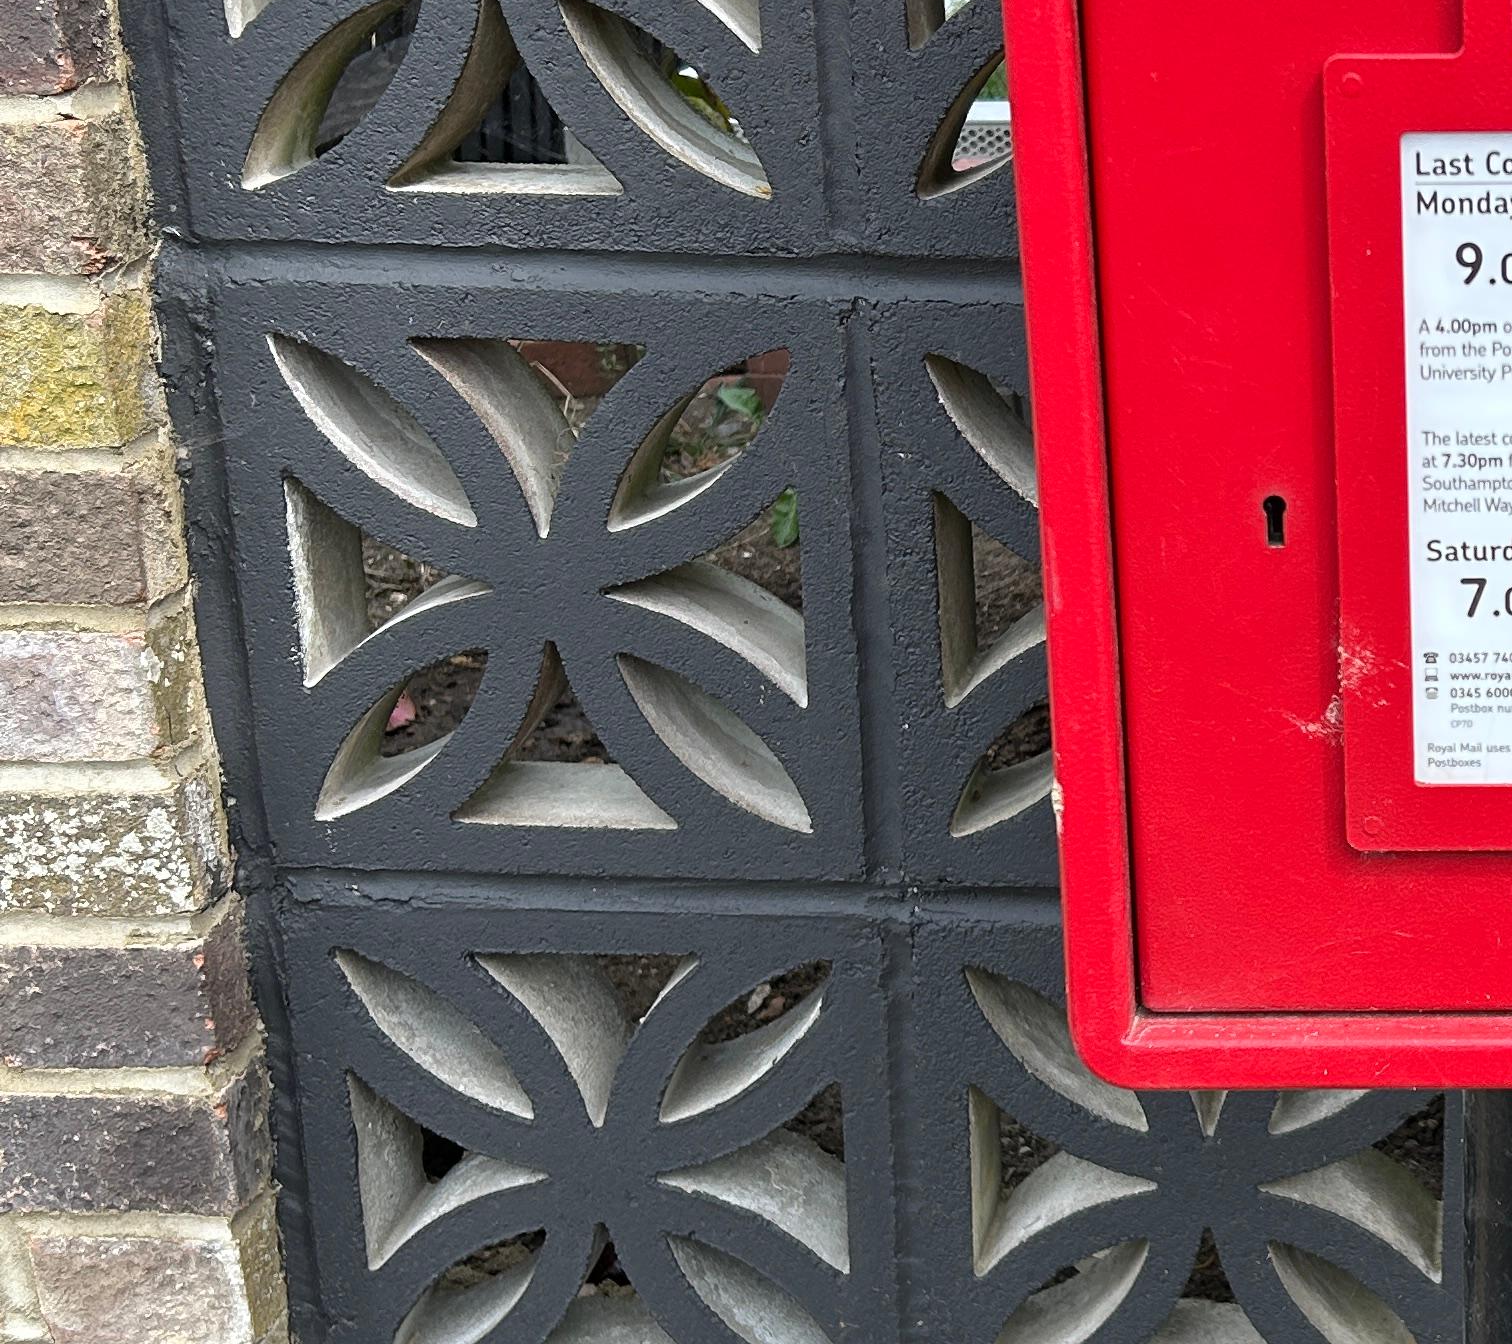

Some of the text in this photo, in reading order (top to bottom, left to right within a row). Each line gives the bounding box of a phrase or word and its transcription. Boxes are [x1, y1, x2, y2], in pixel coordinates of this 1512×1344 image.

[1416, 152, 1474, 176] Last
[1419, 320, 1430, 334] A
[1436, 320, 1497, 337] 4.00pm
[1420, 342, 1456, 357] from
[1462, 342, 1487, 356] the
[1420, 365, 1496, 383] University
[1422, 431, 1450, 446] The
[1456, 431, 1498, 445] latest
[1422, 455, 1438, 468] at
[1442, 454, 1503, 472] 7.30pm
[1423, 498, 1480, 513] Mitchell
[1449, 652, 1488, 663] 03457
[1450, 688, 1481, 698] 0345
[1450, 703, 1493, 713] Postbox
[1428, 743, 1456, 755] Royal
[1460, 743, 1482, 753] Mail
[1487, 745, 1510, 753] uses
[1427, 758, 1481, 768] Postboxes
